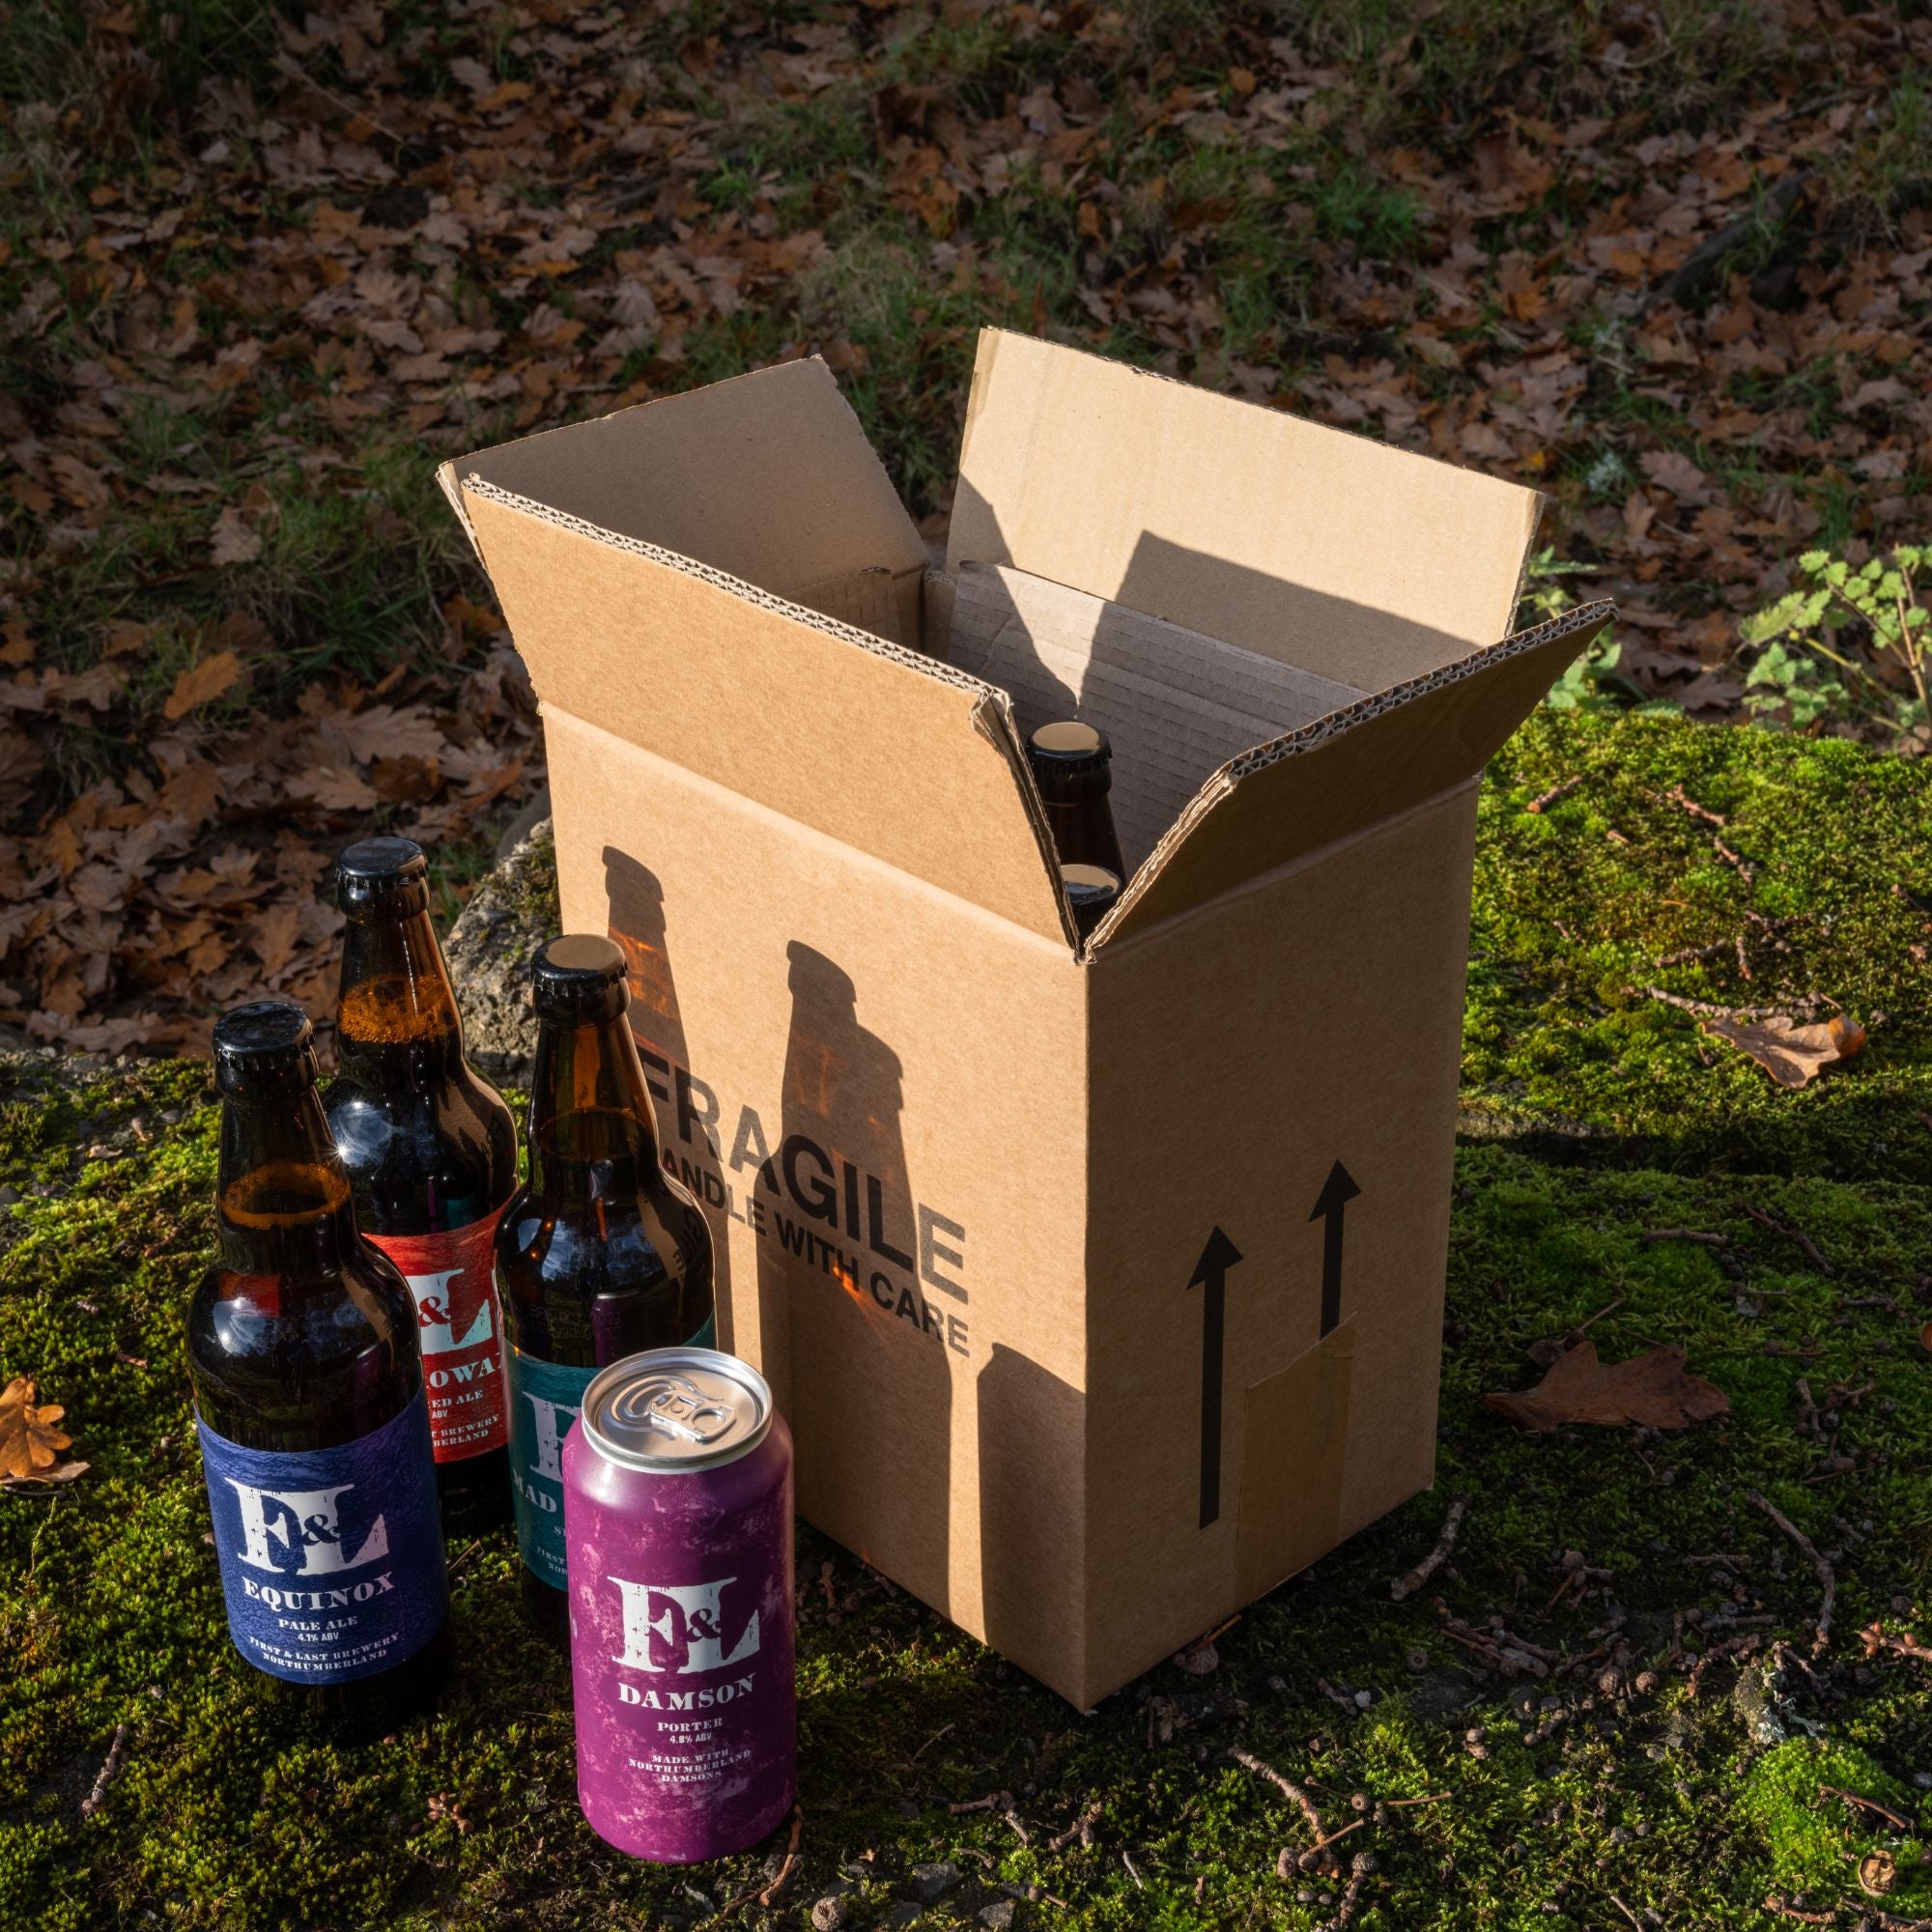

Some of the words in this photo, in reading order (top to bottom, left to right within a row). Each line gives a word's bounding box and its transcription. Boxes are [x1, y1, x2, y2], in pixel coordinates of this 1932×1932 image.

[663, 1147, 767, 1237] ANDLE
[774, 1210, 860, 1293] WITH
[870, 1271, 970, 1358] CARE
[406, 1268, 493, 1355] &L
[427, 1352, 500, 1388] OWA
[428, 1395, 452, 1409] ED
[456, 1389, 484, 1406] ALE
[431, 1409, 448, 1420] ABV
[440, 1414, 500, 1438] BREWERY
[512, 1467, 557, 1514] MAD
[225, 1477, 389, 1577] F&L
[537, 1546, 566, 1563] FIRST
[242, 1571, 395, 1612] EQUINOX
[277, 1618, 321, 1632] PALE
[326, 1615, 358, 1631] ALE
[607, 1576, 761, 1674] F&L
[249, 1635, 281, 1656] FIRST
[284, 1650, 293, 1659] &
[296, 1652, 329, 1662] LAST
[333, 1632, 400, 1661] BREWERY
[298, 1633, 319, 1642] 4.1%
[321, 1632, 340, 1642] ABV
[262, 1649, 388, 1671] NORTHUMBERLAND
[618, 1672, 756, 1711] DAMSON
[657, 1717, 724, 1733] PORTER
[669, 1734, 694, 1745] 4.8%
[695, 1732, 713, 1744] ABV
[628, 1748, 752, 1774] NORTHUMBERLAND
[652, 1754, 690, 1765] MADE
[695, 1747, 729, 1763] WITH
[661, 1771, 723, 1783] DAMSONS
